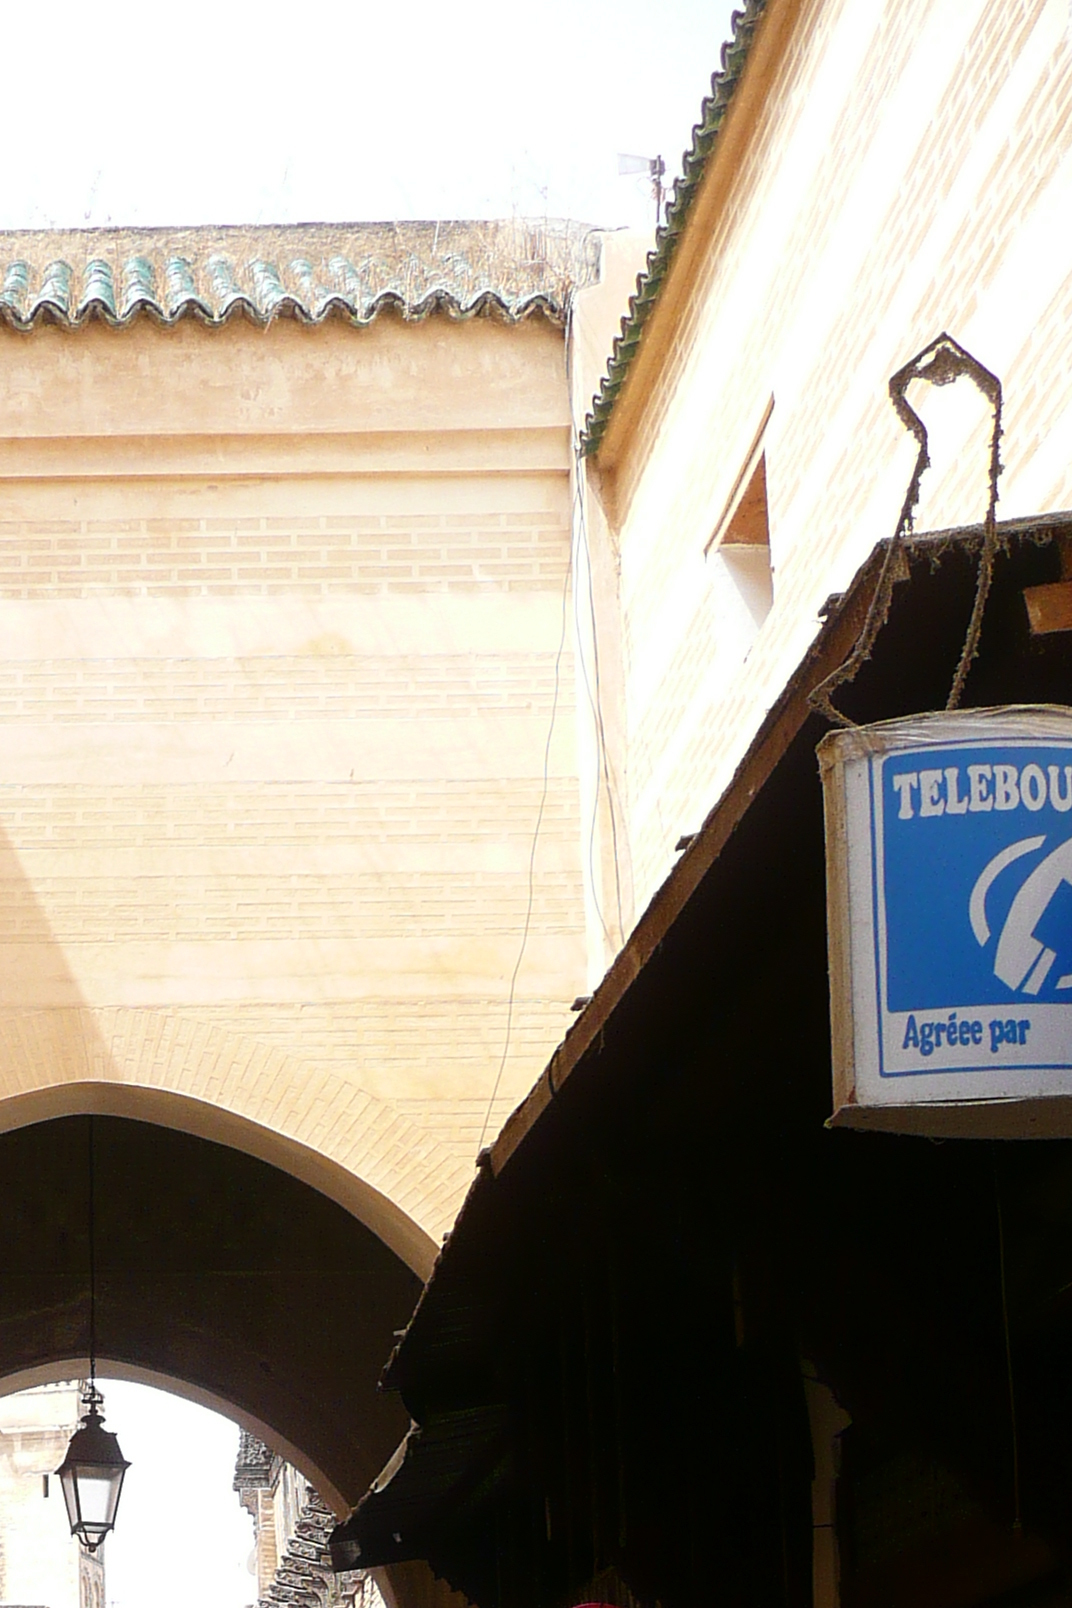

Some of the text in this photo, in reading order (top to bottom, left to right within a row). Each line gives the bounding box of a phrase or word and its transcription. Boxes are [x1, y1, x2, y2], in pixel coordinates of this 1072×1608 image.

[893, 763, 1072, 820] TELEBOU
[903, 1013, 1030, 1056] Agréee par
